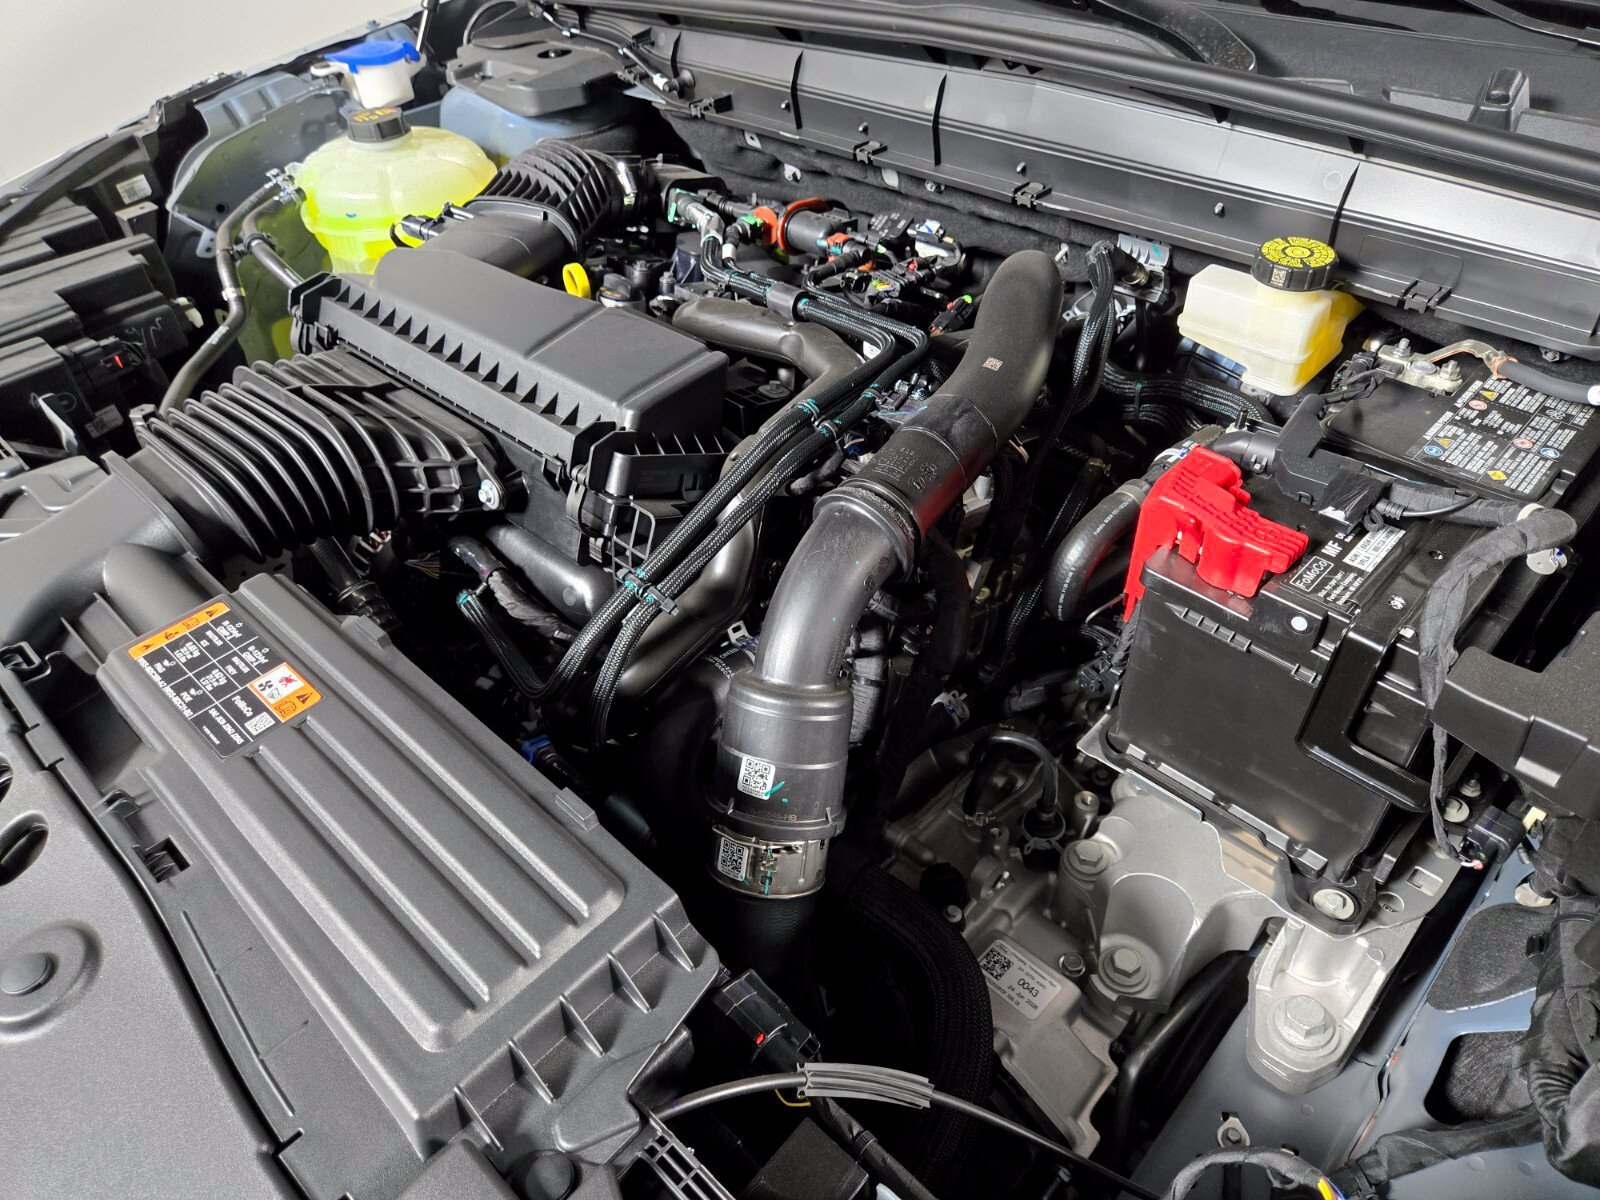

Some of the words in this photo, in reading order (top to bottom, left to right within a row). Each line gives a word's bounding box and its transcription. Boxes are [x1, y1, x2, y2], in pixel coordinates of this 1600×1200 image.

[1321, 540, 1343, 557] MF
[1296, 561, 1327, 589] FoMoCo
[231, 695, 255, 717] FoMoCo
[1018, 978, 1040, 998] 0043
